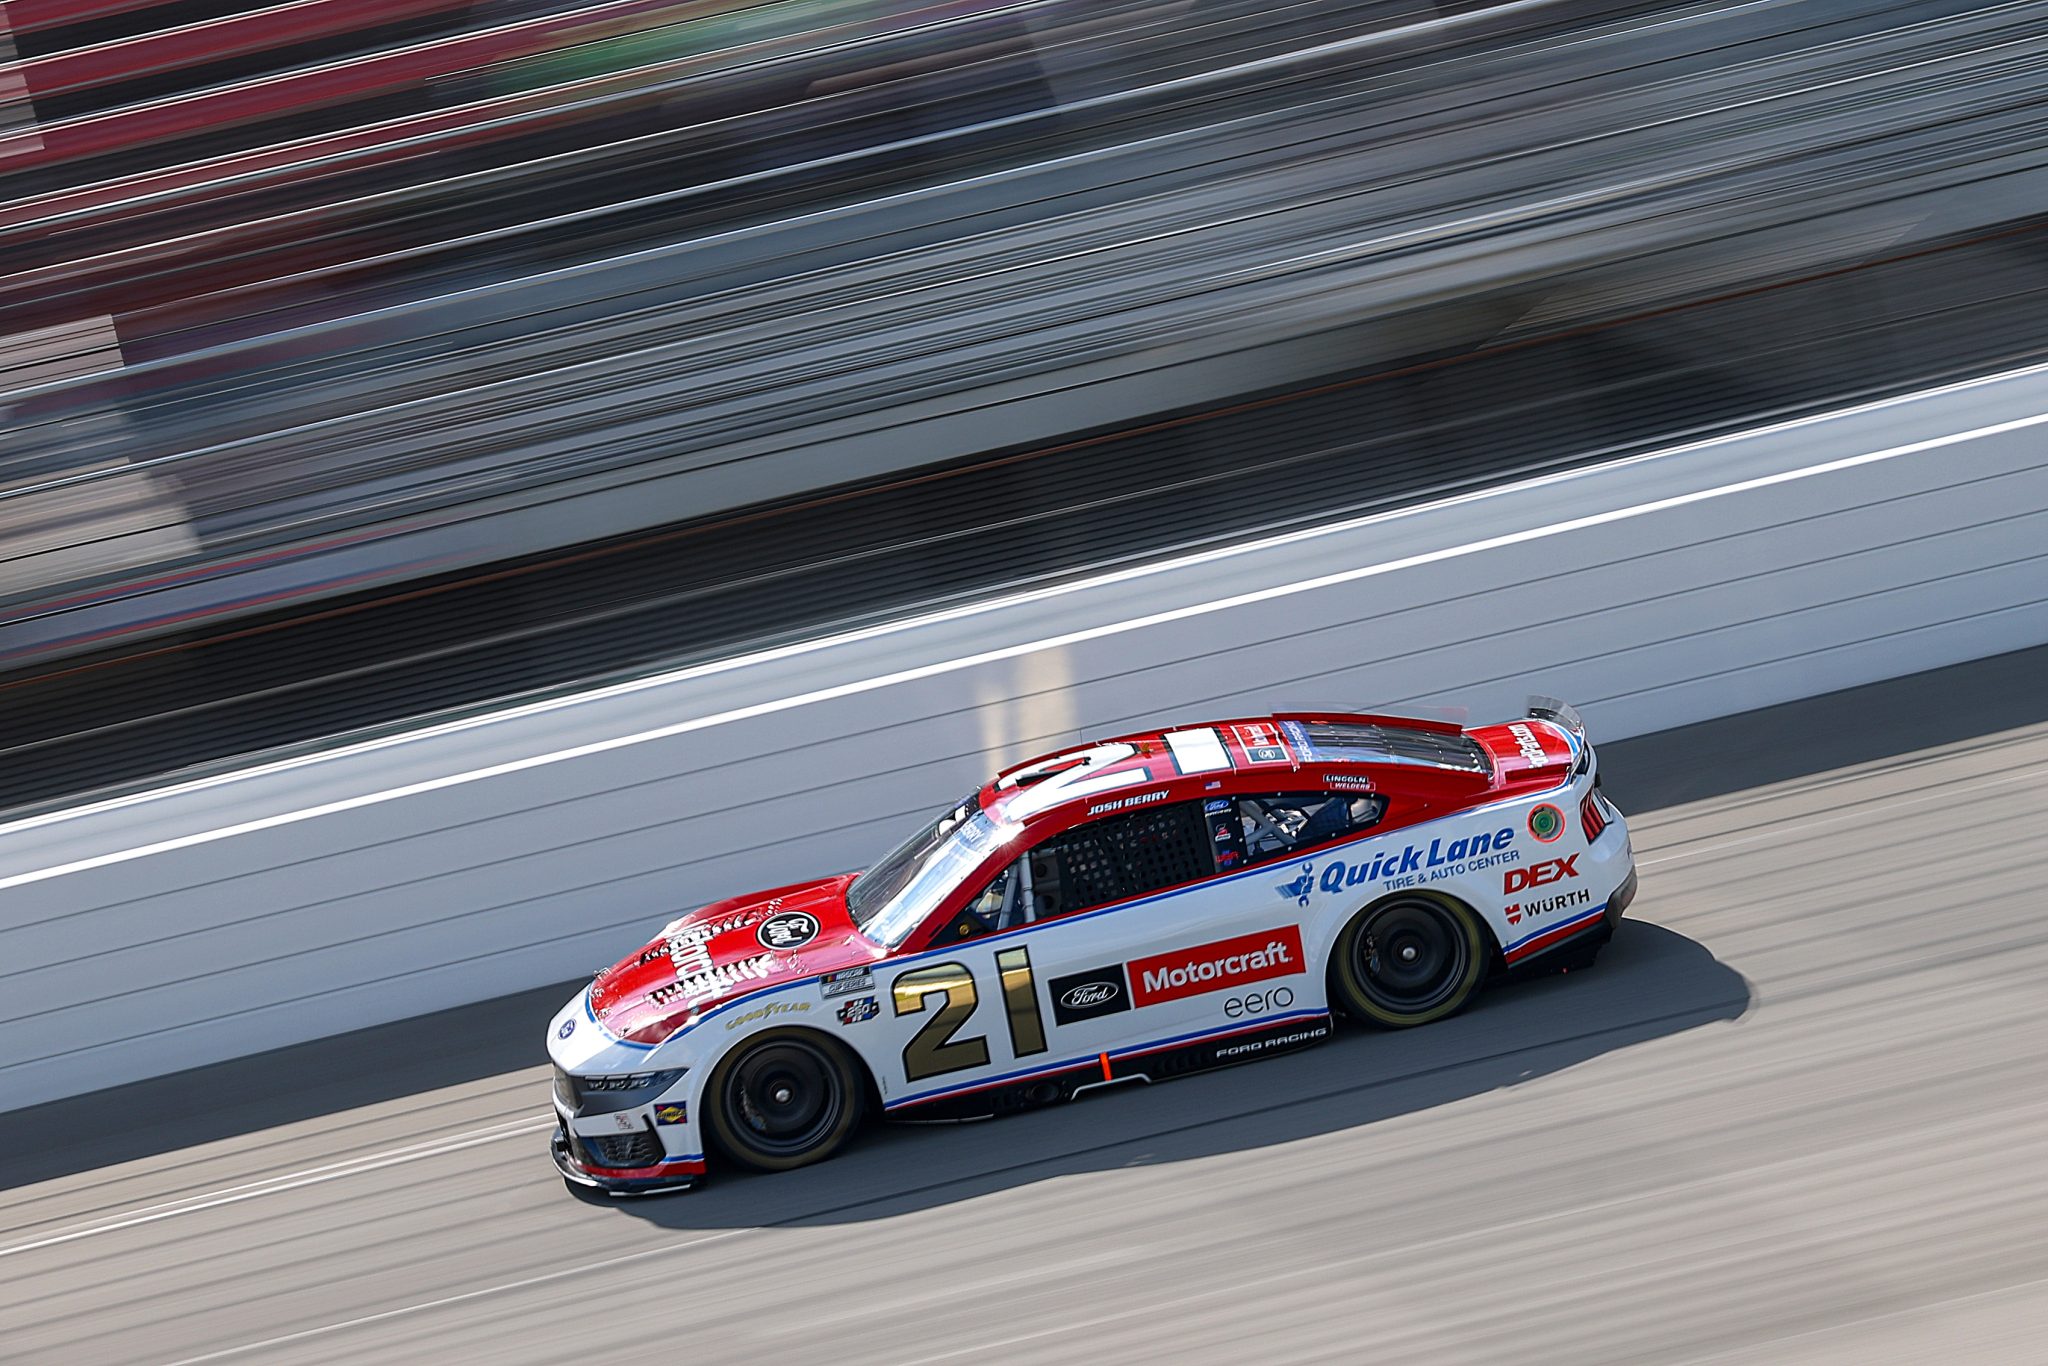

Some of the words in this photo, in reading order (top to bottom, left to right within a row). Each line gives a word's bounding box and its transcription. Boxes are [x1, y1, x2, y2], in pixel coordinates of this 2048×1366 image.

[1326, 775, 1366, 783] LINCOLN
[1335, 782, 1370, 790] WELDERS
[1087, 800, 1122, 816] JOSH
[1125, 790, 1170, 807] BERRY
[1320, 845, 1424, 894] Quick
[1426, 827, 1515, 867] Lane
[1383, 874, 1415, 891] TIRE
[1417, 874, 1427, 883] &
[1430, 864, 1466, 881] AUTO
[1467, 850, 1520, 872] CENTER
[1504, 852, 1580, 896] DEX
[1524, 888, 1590, 917] WÜRTH
[1071, 986, 1110, 1006] Ford
[1223, 986, 1294, 1018] eero
[726, 1002, 811, 1031] GOODYEAR
[890, 944, 1048, 1083] 21
[1216, 1042, 1262, 1058] FORD
[1265, 1028, 1327, 1048] RACING
